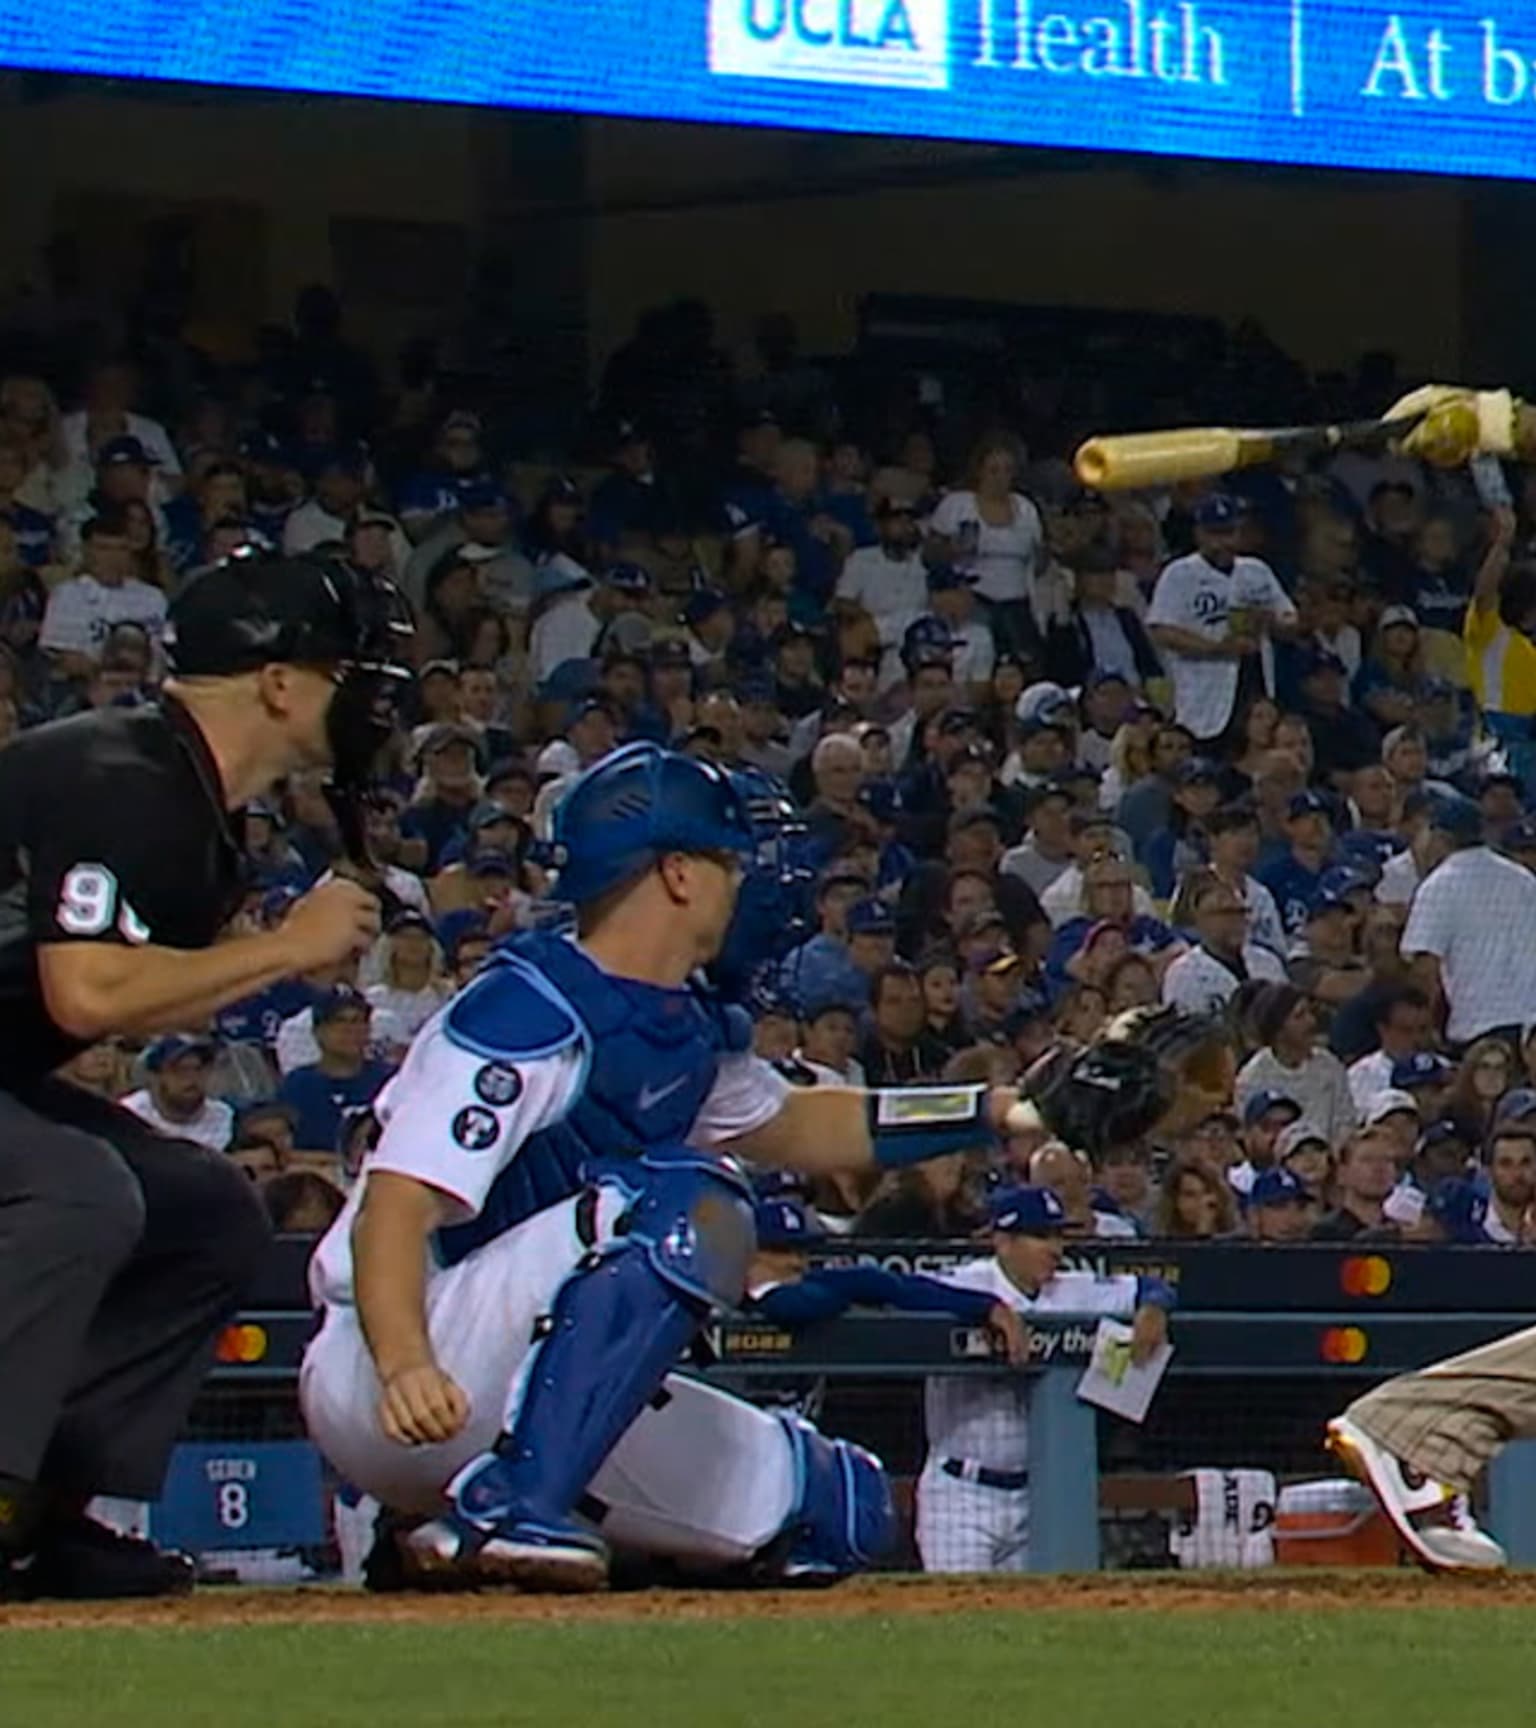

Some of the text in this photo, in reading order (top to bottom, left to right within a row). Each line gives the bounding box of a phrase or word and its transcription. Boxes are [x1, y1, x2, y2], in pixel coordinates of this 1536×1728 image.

[742, 0, 1228, 85] UCLA Health
[1360, 15, 1453, 100] At
[221, 1482, 248, 1528] 8
